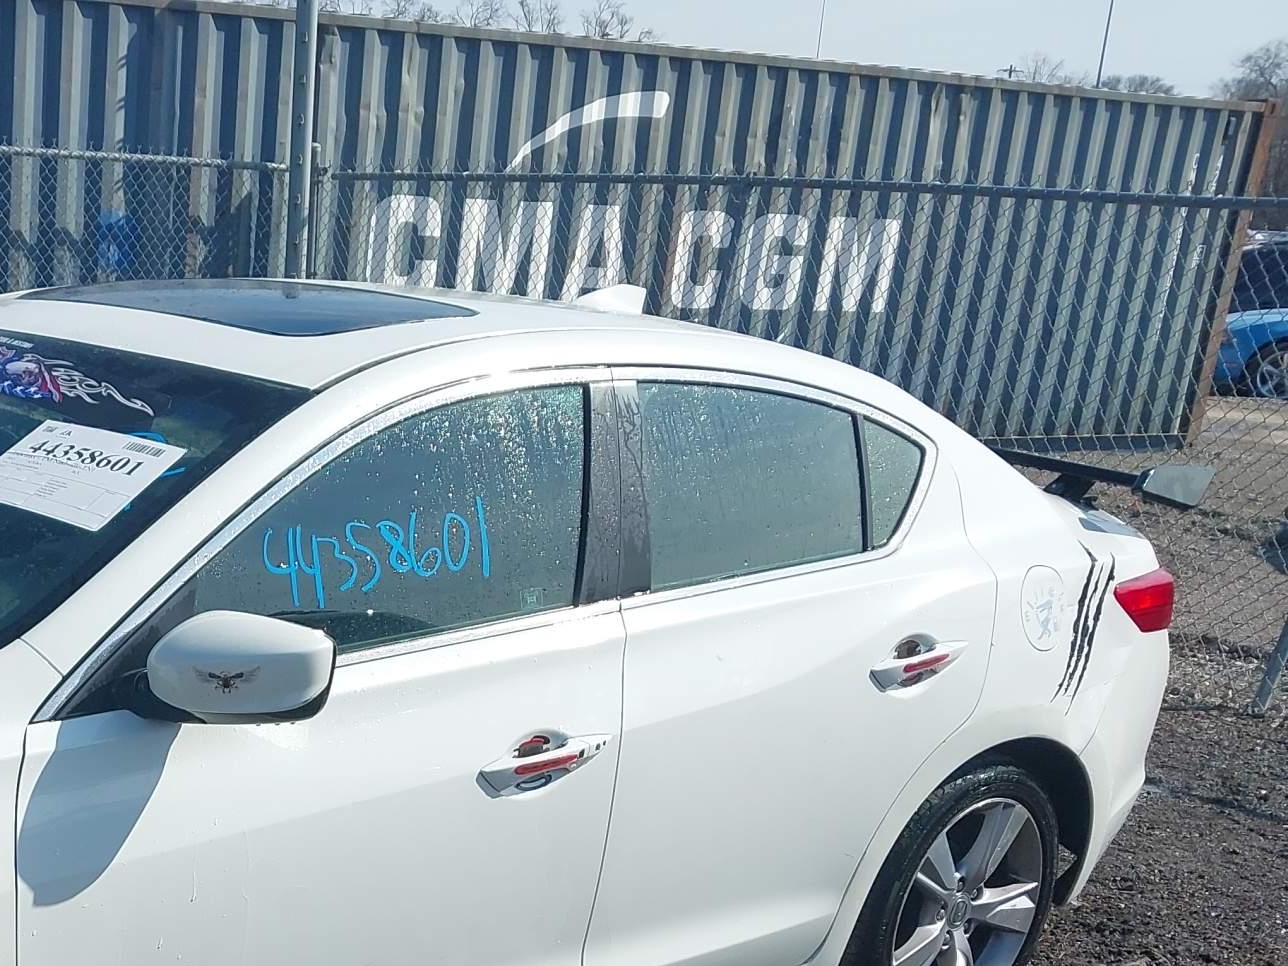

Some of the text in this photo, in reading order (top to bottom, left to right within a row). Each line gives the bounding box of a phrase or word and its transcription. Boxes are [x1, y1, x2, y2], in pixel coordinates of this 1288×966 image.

[368, 194, 902, 313] CMA CGM
[28, 440, 144, 476] 44358601
[263, 496, 491, 609] 44358601
